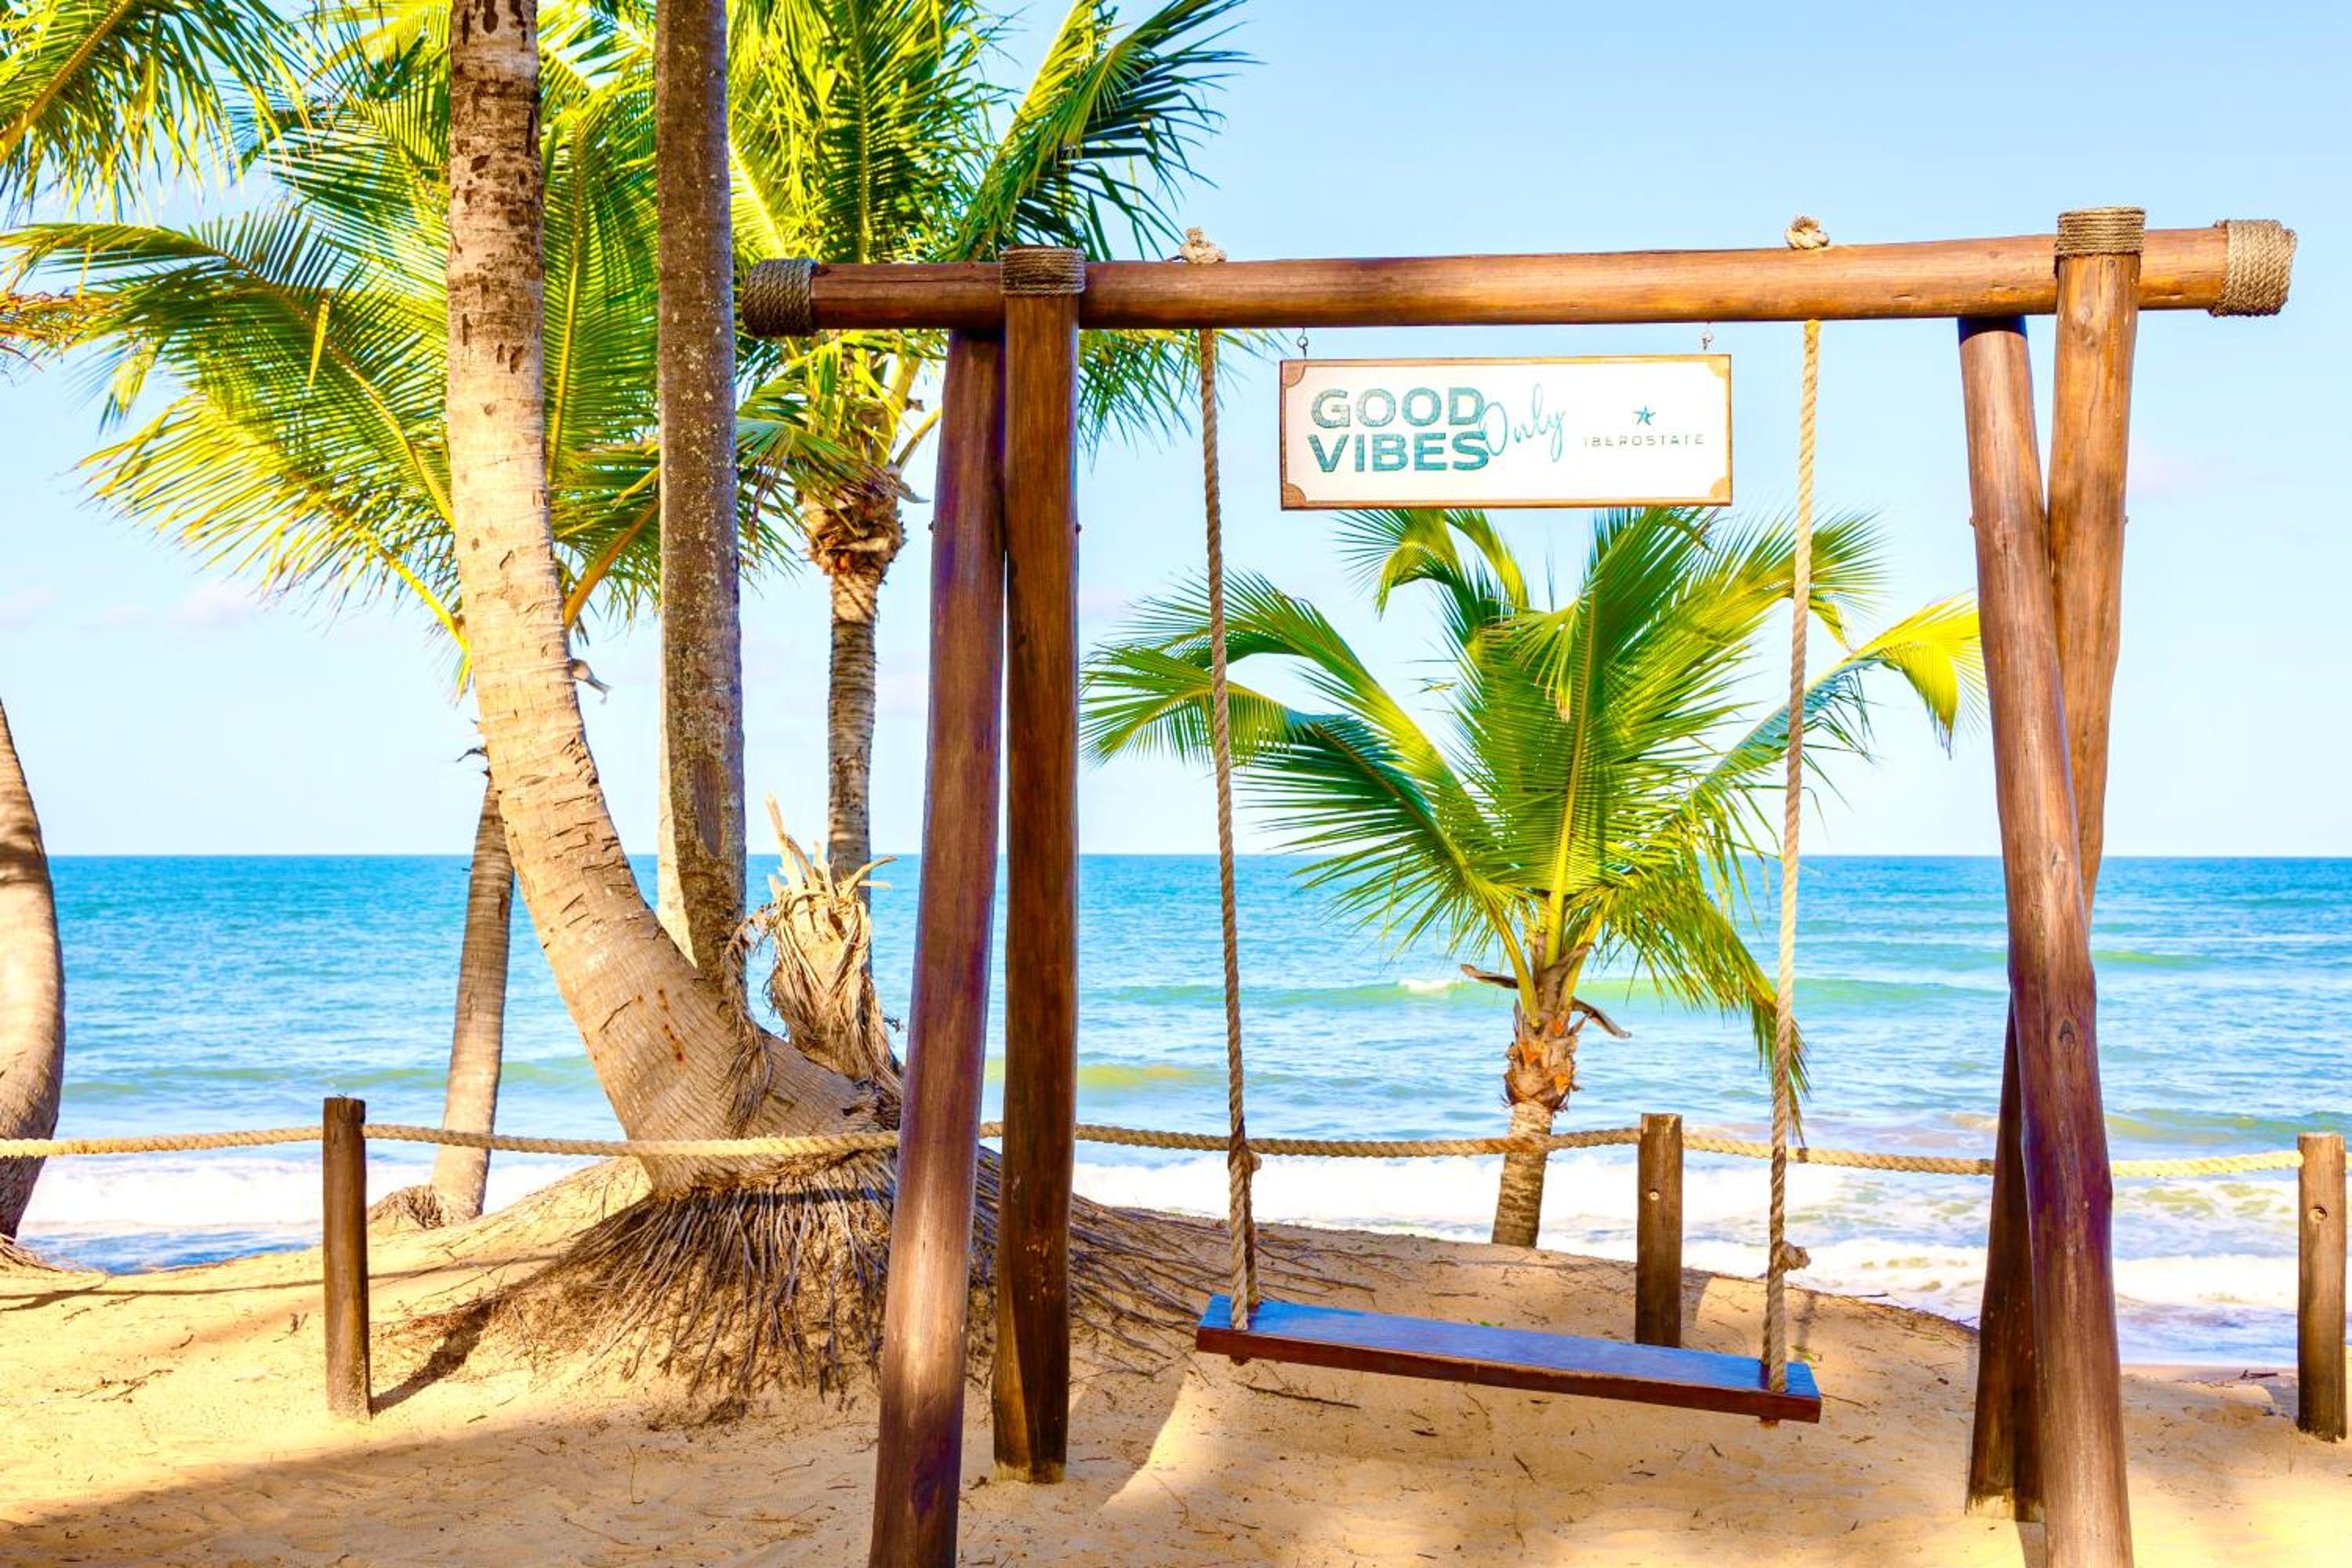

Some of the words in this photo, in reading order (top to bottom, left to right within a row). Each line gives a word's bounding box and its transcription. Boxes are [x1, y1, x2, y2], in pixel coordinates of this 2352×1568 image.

[1312, 387, 1484, 428] GOOD
[1479, 383, 1566, 463] Only
[1307, 431, 1490, 473] VIBES
